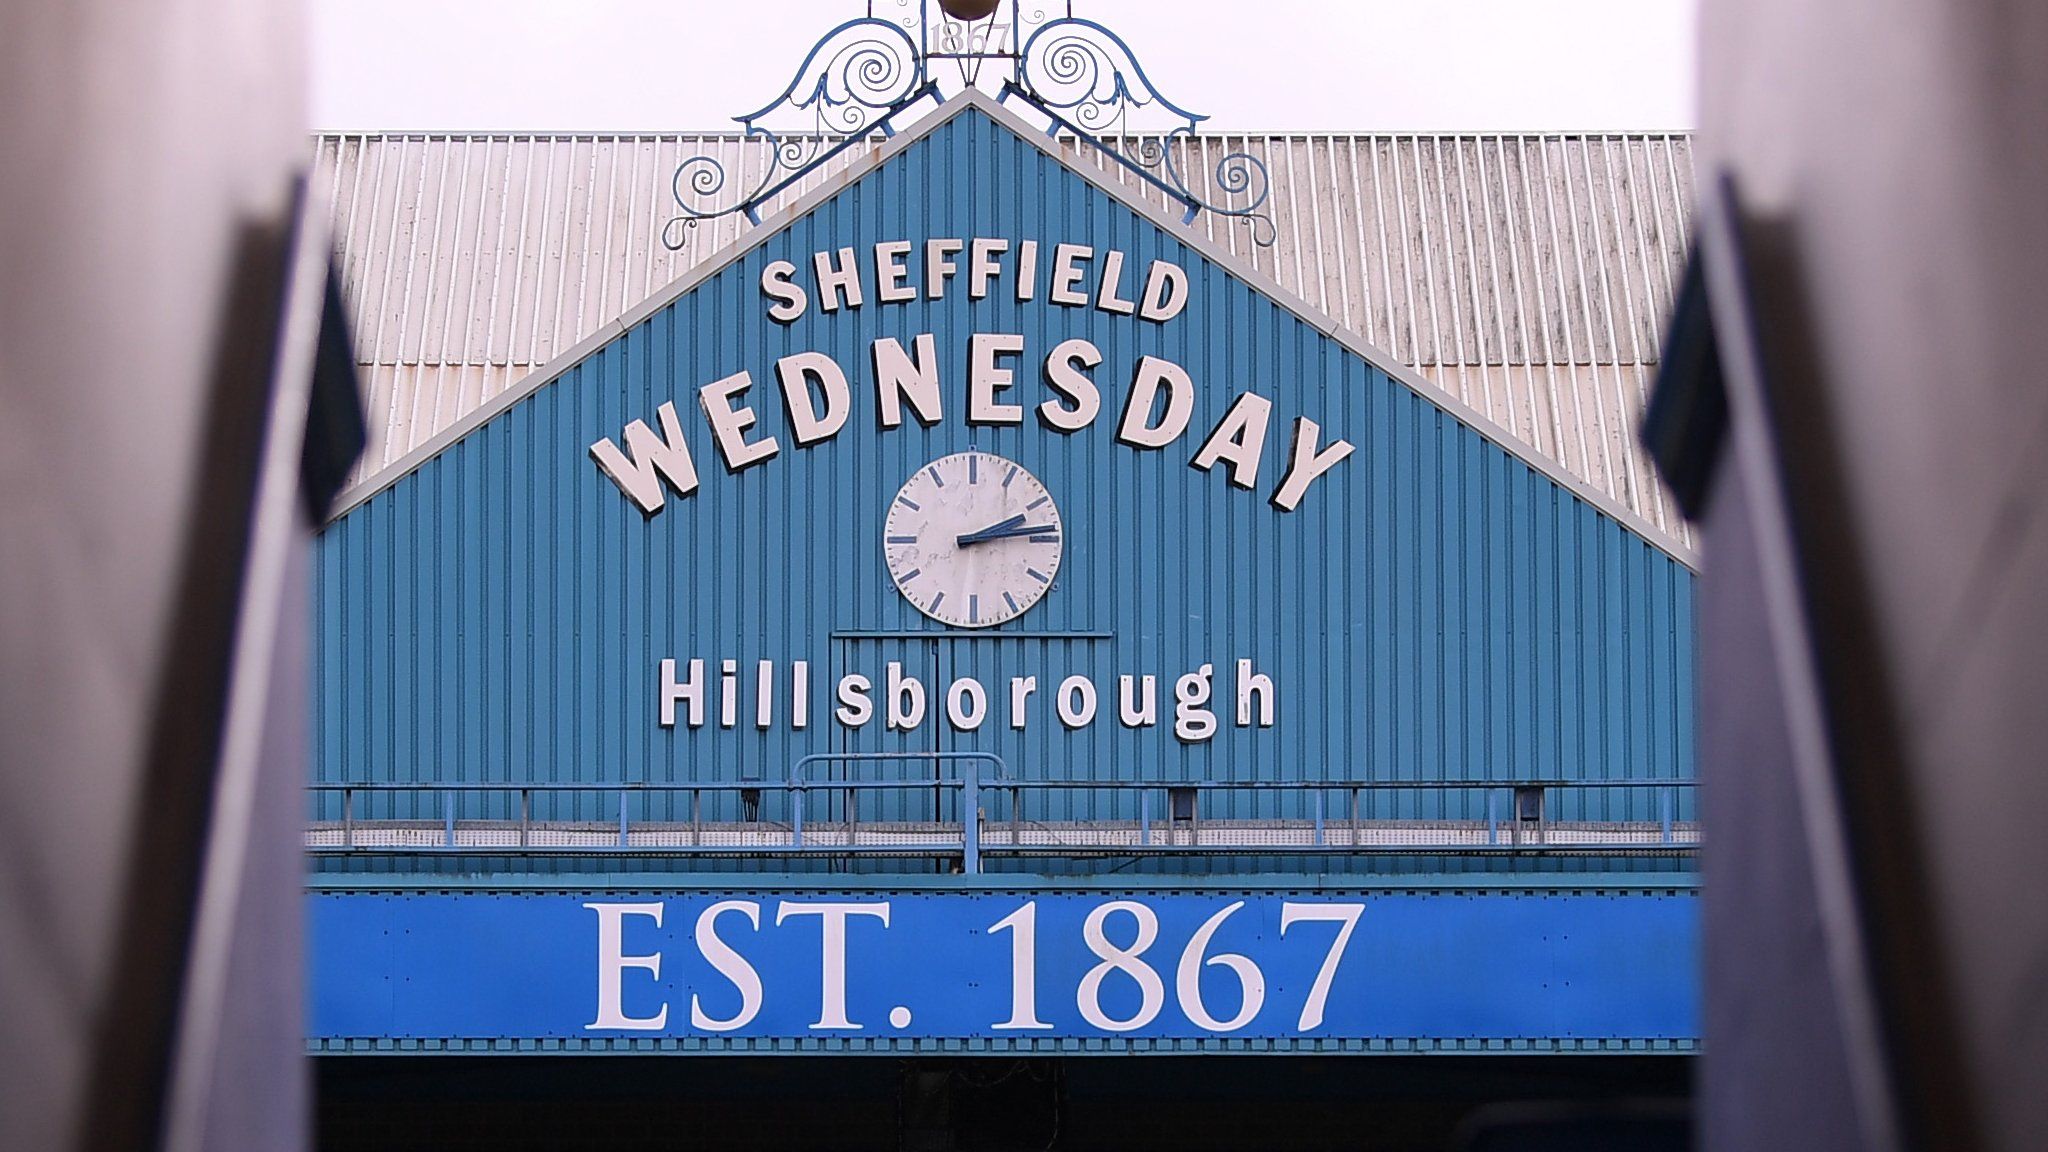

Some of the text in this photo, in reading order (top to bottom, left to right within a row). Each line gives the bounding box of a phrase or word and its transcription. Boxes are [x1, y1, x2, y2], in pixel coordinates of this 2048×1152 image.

[931, 22, 1011, 54] 1867
[760, 238, 1189, 322] SHEFFIELD
[590, 334, 1355, 519] WEDNESDAY
[659, 658, 1274, 743] Hillsborough
[583, 900, 1366, 1032] EST. 1867
